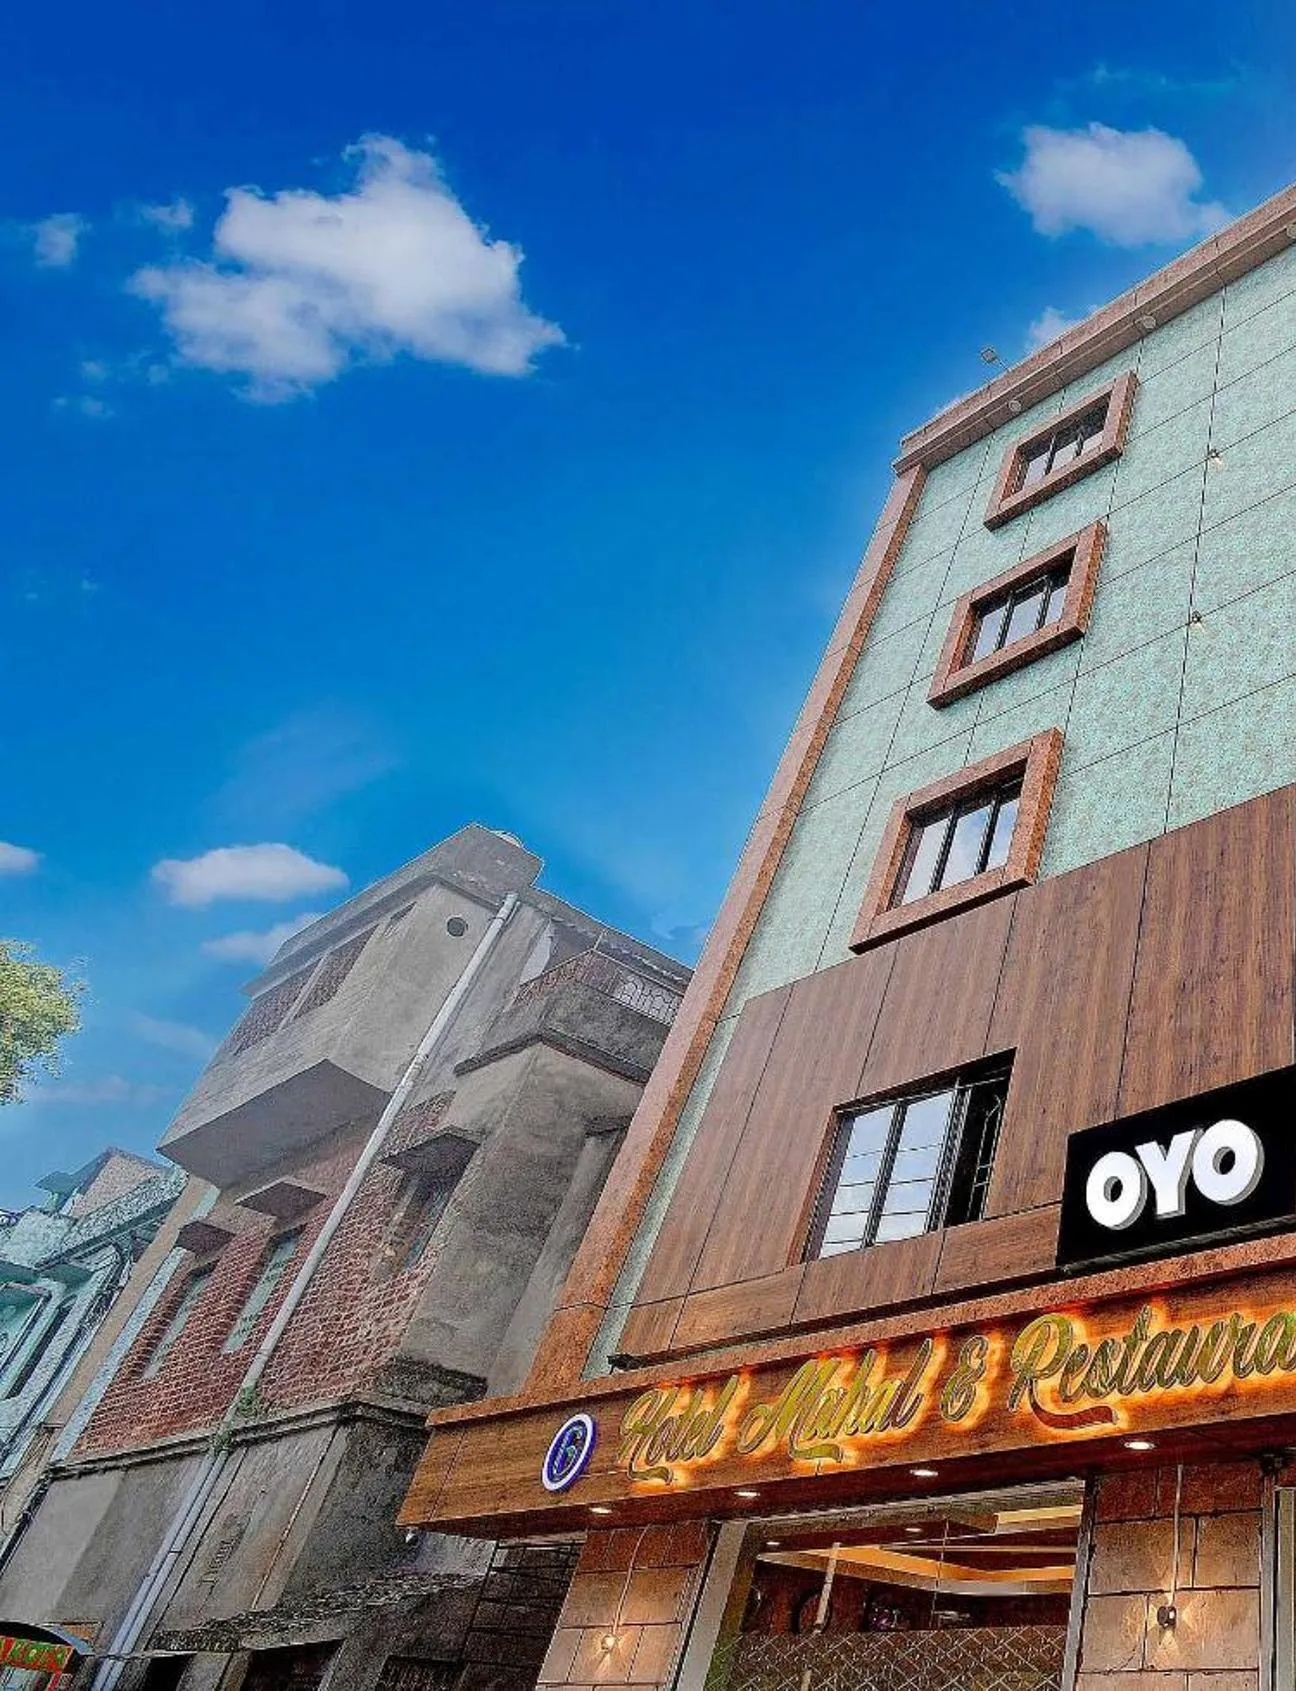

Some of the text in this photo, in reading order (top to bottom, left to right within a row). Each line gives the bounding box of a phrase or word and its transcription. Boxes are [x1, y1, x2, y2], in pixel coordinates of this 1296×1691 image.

[1086, 1119, 1265, 1230] OYO
[617, 1374, 738, 1485] Hotel
[736, 1337, 934, 1463] Mahal
[940, 1335, 988, 1422] &
